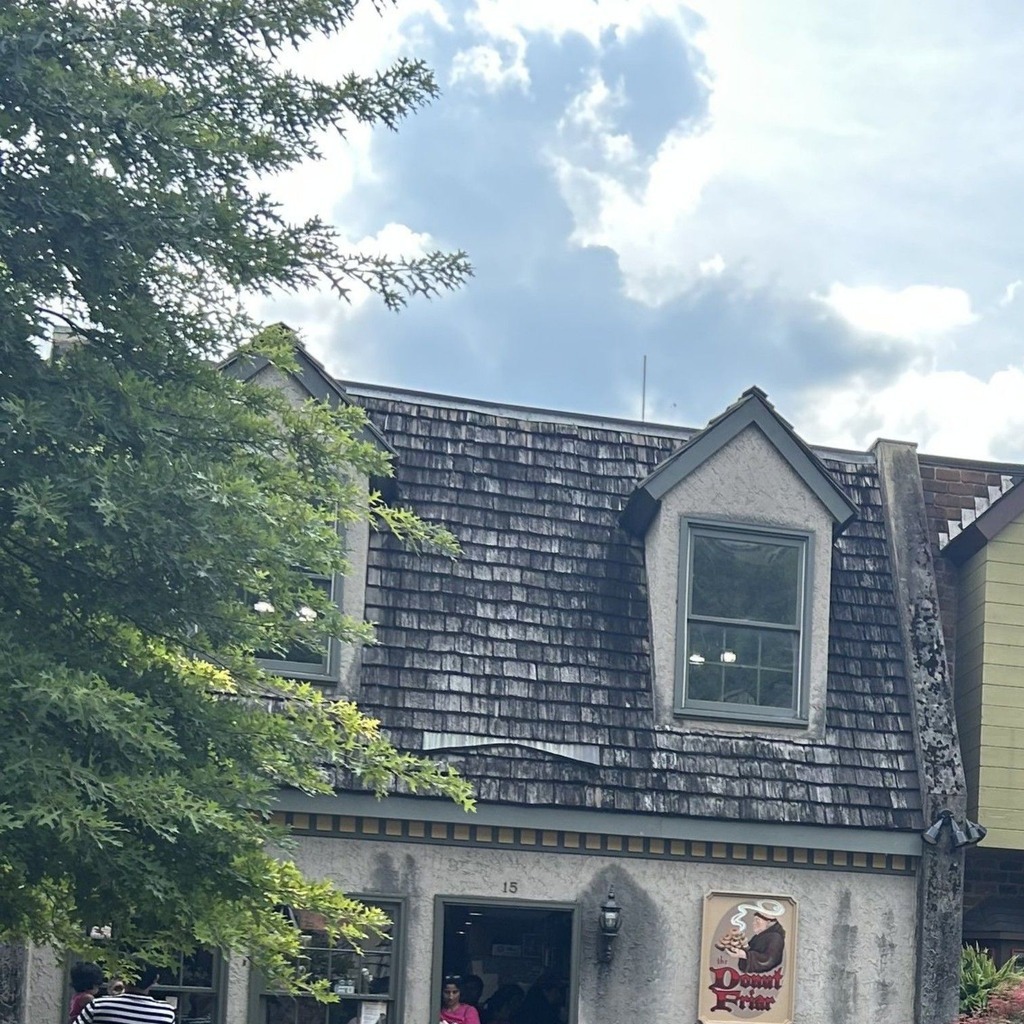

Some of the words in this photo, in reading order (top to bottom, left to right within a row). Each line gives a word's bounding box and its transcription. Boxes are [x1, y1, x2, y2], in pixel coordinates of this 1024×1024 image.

[502, 881, 518, 894] 15
[708, 966, 784, 990] Donut
[710, 989, 776, 1012] Friar
